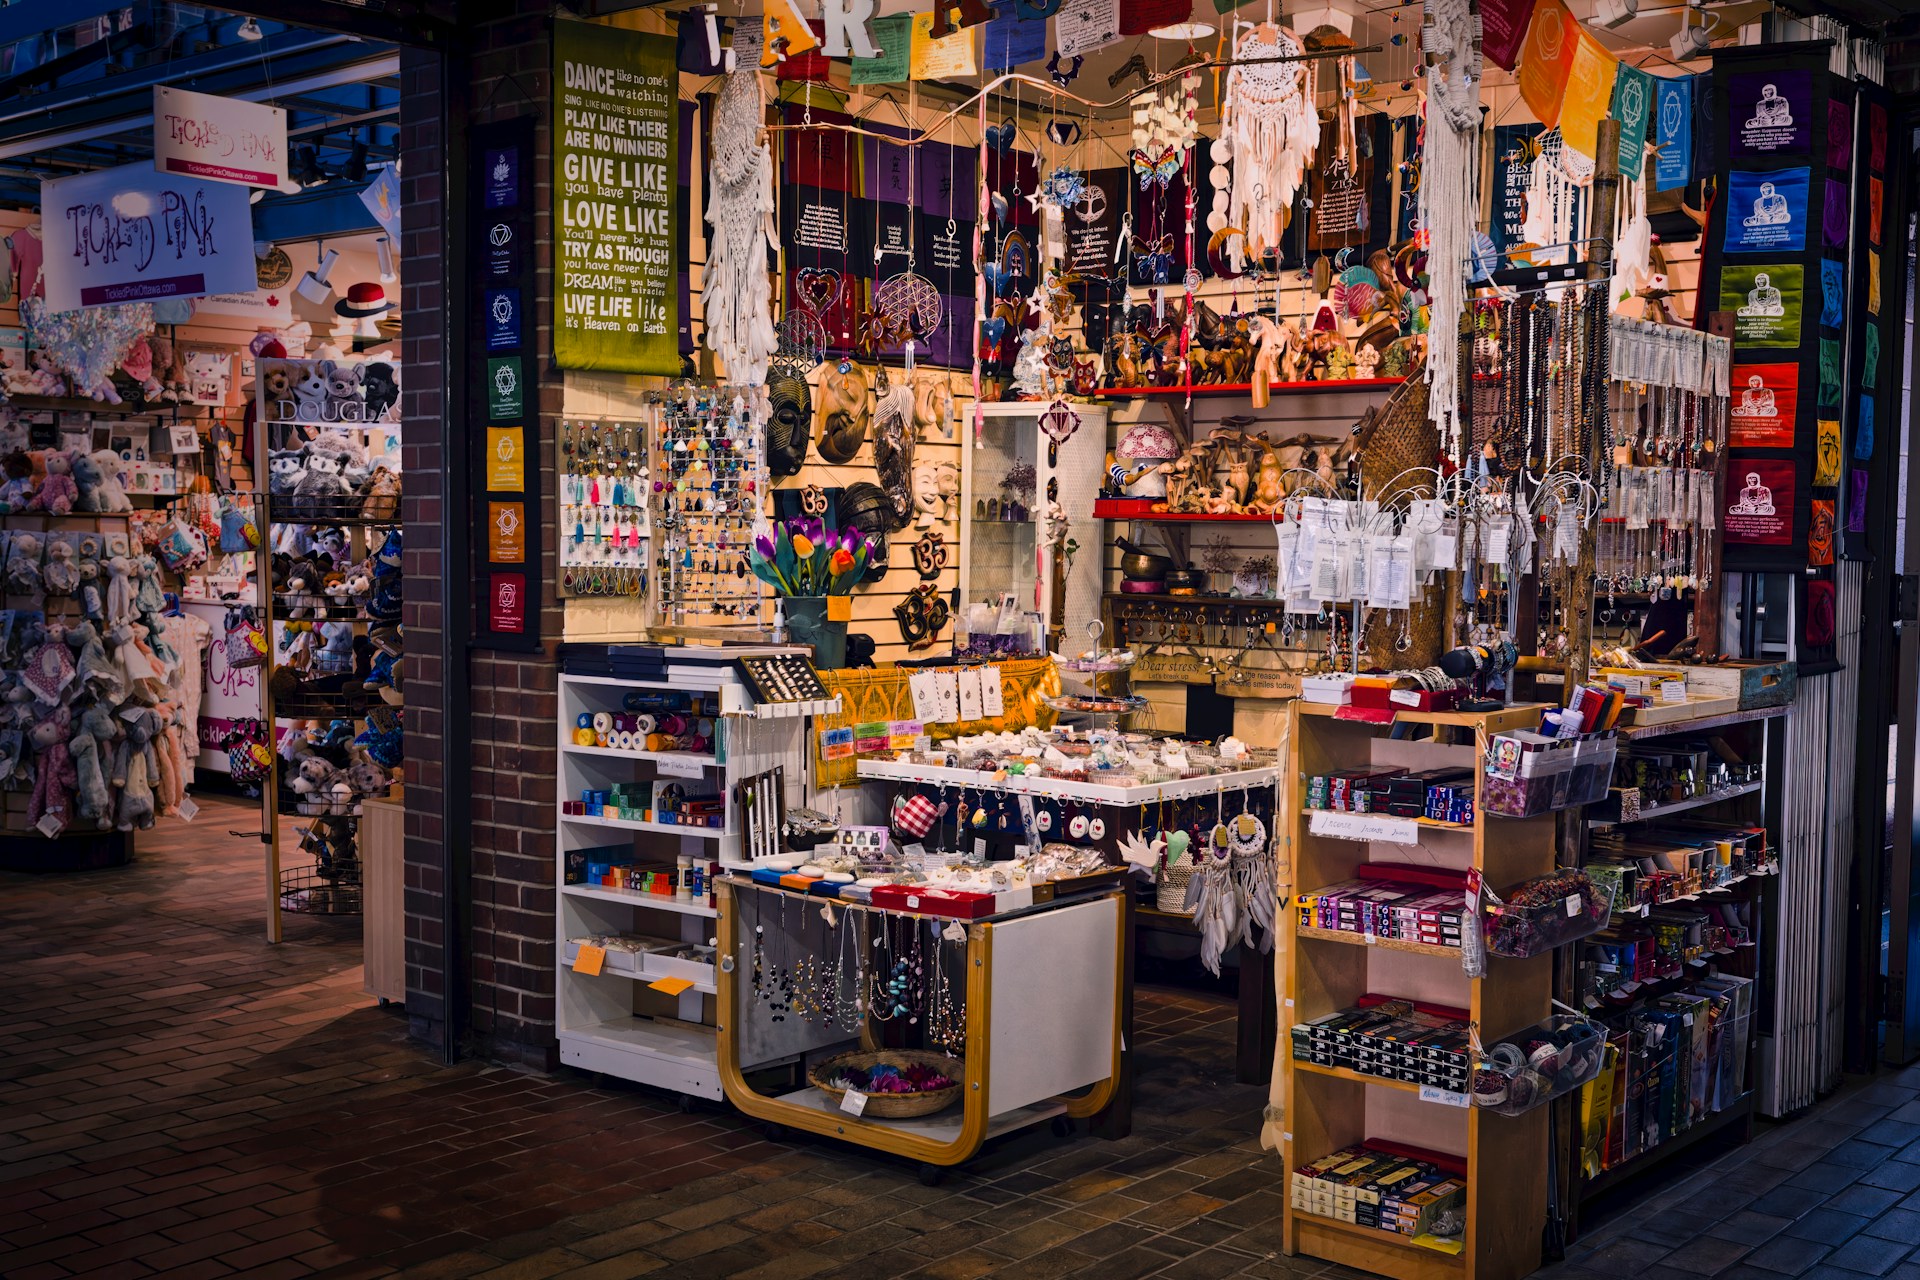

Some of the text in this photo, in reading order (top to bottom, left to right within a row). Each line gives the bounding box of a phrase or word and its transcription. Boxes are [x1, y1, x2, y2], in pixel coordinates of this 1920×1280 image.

[565, 61, 668, 96] DANCE like no one's
[564, 94, 668, 119] SING LIKE NO ONE'S LISTENING
[617, 88, 668, 107] watching
[565, 109, 668, 139] PLAY LIKE THERE
[564, 129, 667, 159] ARE NO WINNERS
[187, 164, 258, 181] TickledPinkOttawa.com
[564, 153, 667, 191] GIVE LIKE
[565, 182, 668, 207] you have plenty
[563, 199, 669, 236] LOVE LIKE
[564, 228, 669, 247] You'll never be hurt
[563, 241, 669, 265] TRY AS THOUGH
[564, 259, 669, 277] you have never failed
[564, 272, 613, 289] DREAM
[614, 276, 626, 284] like
[630, 279, 643, 287] you
[614, 284, 665, 296] in miracles
[105, 282, 177, 300] TickledPinkOttawa.com
[210, 296, 239, 305] Canadian
[564, 293, 666, 320] LIVE LIFE like
[565, 315, 667, 334] it's Heaven on Earth
[1140, 661, 1199, 673] Dear stress,
[1276, 681, 1296, 690] today.
